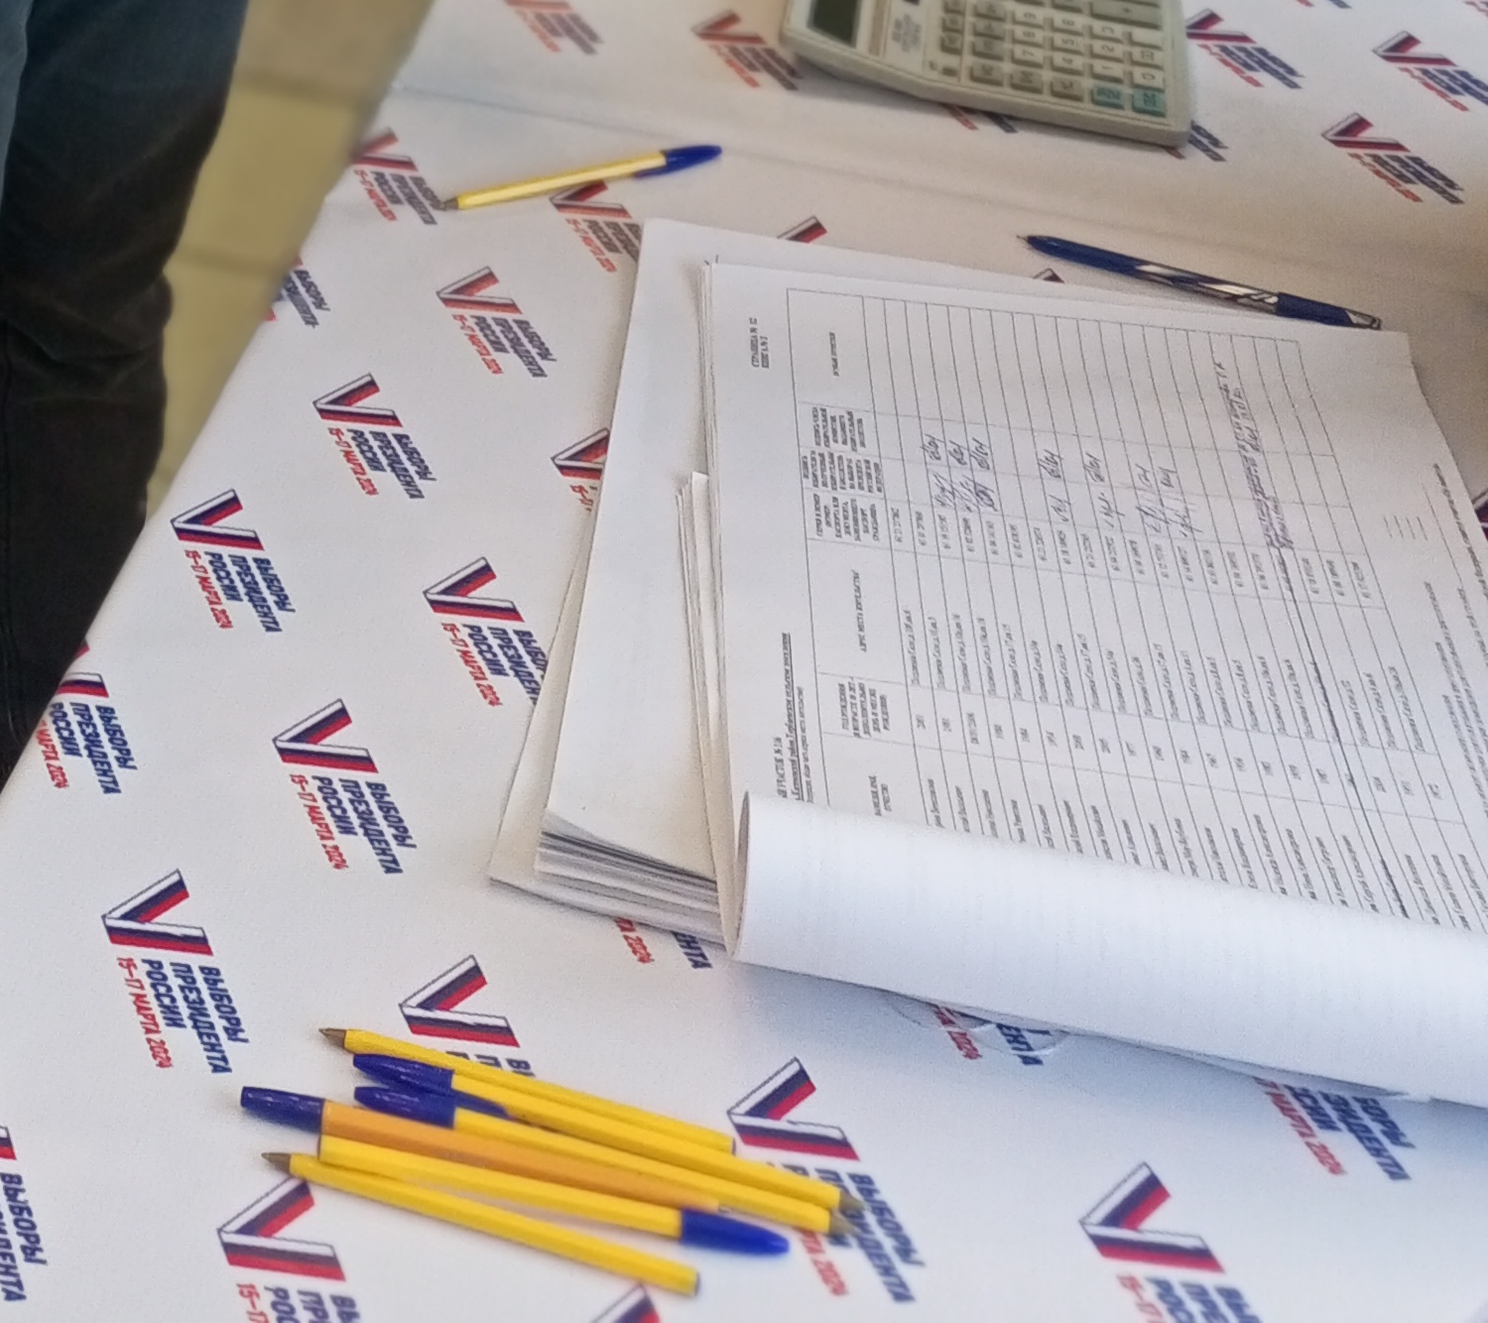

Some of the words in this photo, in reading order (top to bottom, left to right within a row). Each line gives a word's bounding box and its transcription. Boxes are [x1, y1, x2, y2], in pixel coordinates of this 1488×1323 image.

[342, 450, 367, 475] МАРТА
[355, 477, 379, 496] 2024
[346, 428, 387, 472] РОССИИ
[368, 430, 425, 499] ПРЕЗИДЕНТА
[391, 432, 437, 481] ВЫБОРЫ
[195, 574, 222, 605] МАРТА
[209, 606, 234, 629] 2024
[203, 551, 244, 602] РОССИИ
[227, 553, 282, 632] ПРЕЗИДЕНТА
[251, 557, 296, 613] ВЫБОРЫ
[456, 648, 488, 681] МАРТА
[475, 682, 503, 707] 2024
[461, 623, 510, 677] РОССИИ
[487, 626, 541, 707] ПРЕЗИДЕН
[32, 727, 59, 761] МАРТА
[45, 702, 83, 757] РОССИИ
[69, 701, 121, 794] ПРЕЗИДЕНТА
[95, 704, 137, 770] ВЫБОРЫ
[45, 762, 69, 789] 2024
[311, 775, 358, 836] РОССИИ
[338, 778, 403, 874] ПРЕЗИДЕНТА
[365, 781, 417, 849] ВЫБОРЫ
[303, 804, 335, 841] МАРТА
[321, 843, 349, 870] 2024
[129, 992, 162, 1035] МАРТА
[140, 958, 187, 1028] РОССИИ
[169, 961, 232, 1073] ПРЕЗИДЕНТА
[198, 965, 249, 1043] ВЫБОРЫ
[145, 1037, 172, 1068] 2024
